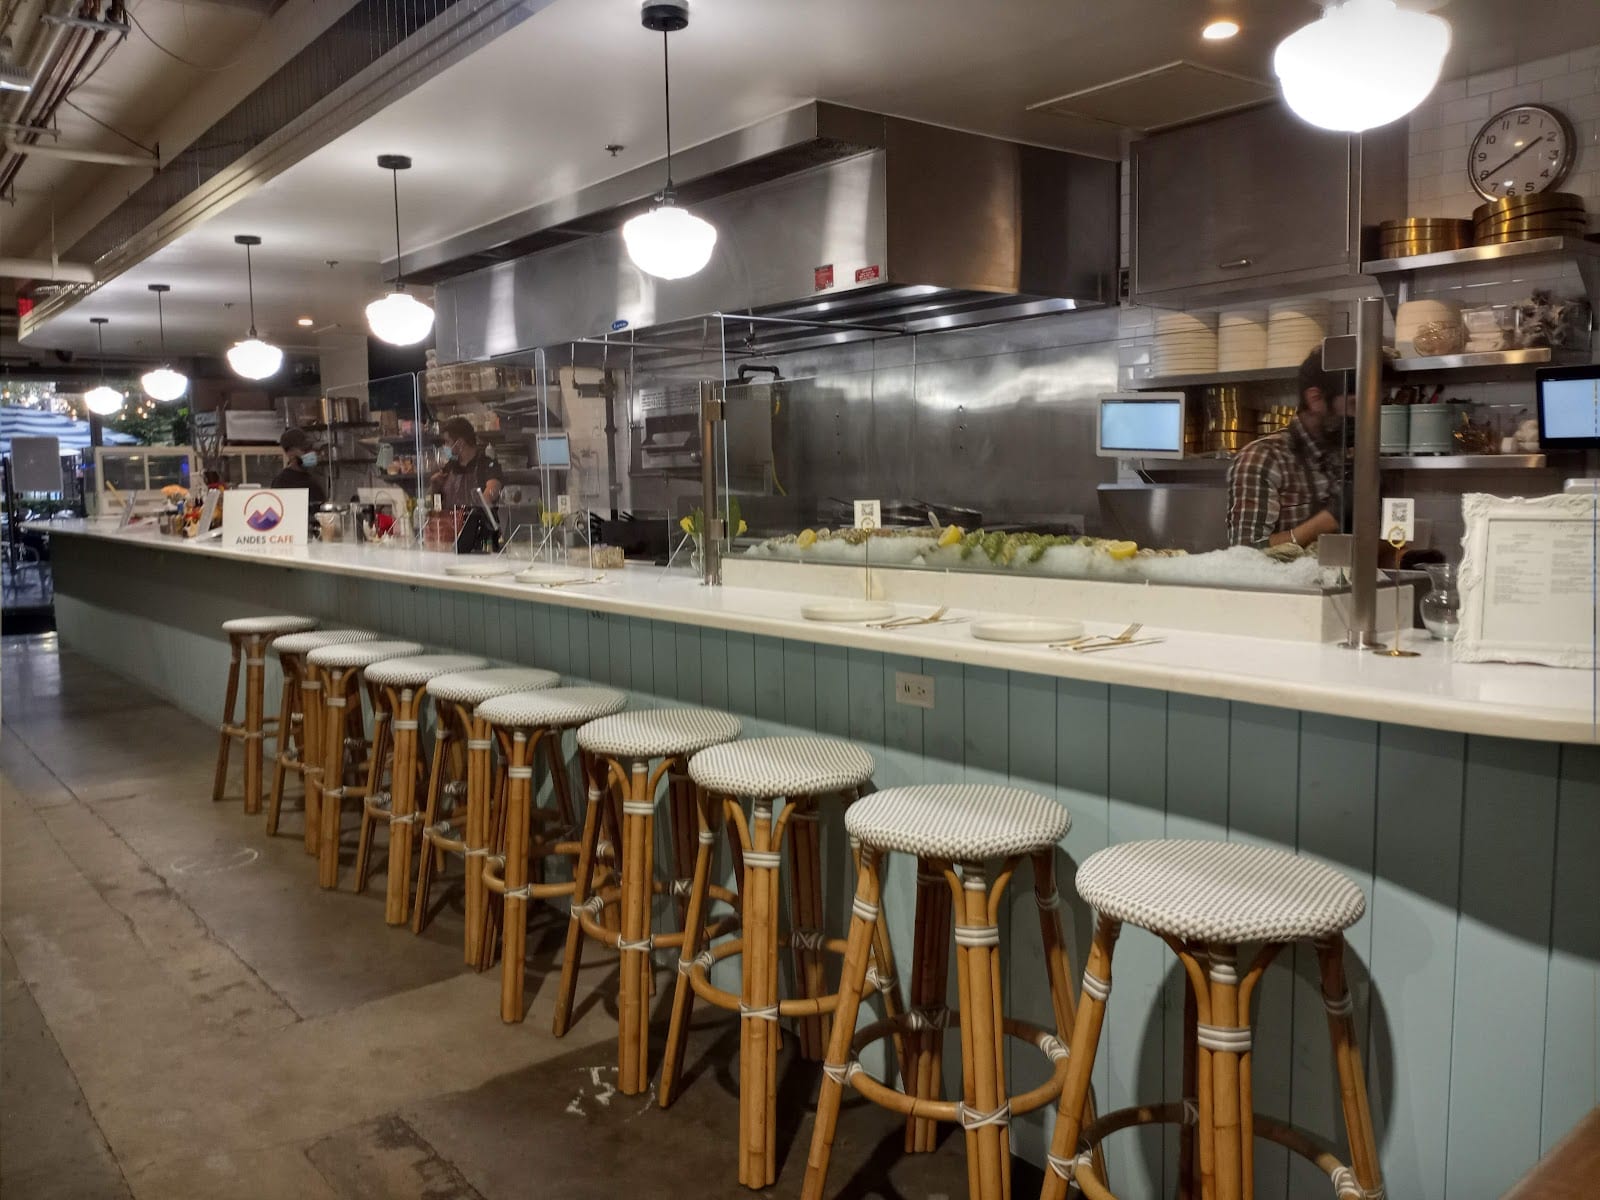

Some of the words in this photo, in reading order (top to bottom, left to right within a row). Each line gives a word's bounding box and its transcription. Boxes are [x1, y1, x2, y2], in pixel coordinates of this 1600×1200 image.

[1517, 114, 1530, 125] 12
[1502, 121, 1509, 130] 11
[1486, 135, 1496, 145] 10
[1546, 131, 1557, 142] 2
[1478, 152, 1487, 162] 9
[1548, 149, 1559, 160] 3
[1480, 170, 1489, 180] 8
[1540, 168, 1549, 178] 4
[1491, 182, 1499, 192] 7
[1506, 187, 1515, 197] 6
[1524, 182, 1535, 192] 5
[235, 536, 267, 545] ANDES
[269, 535, 294, 545] CAFE
